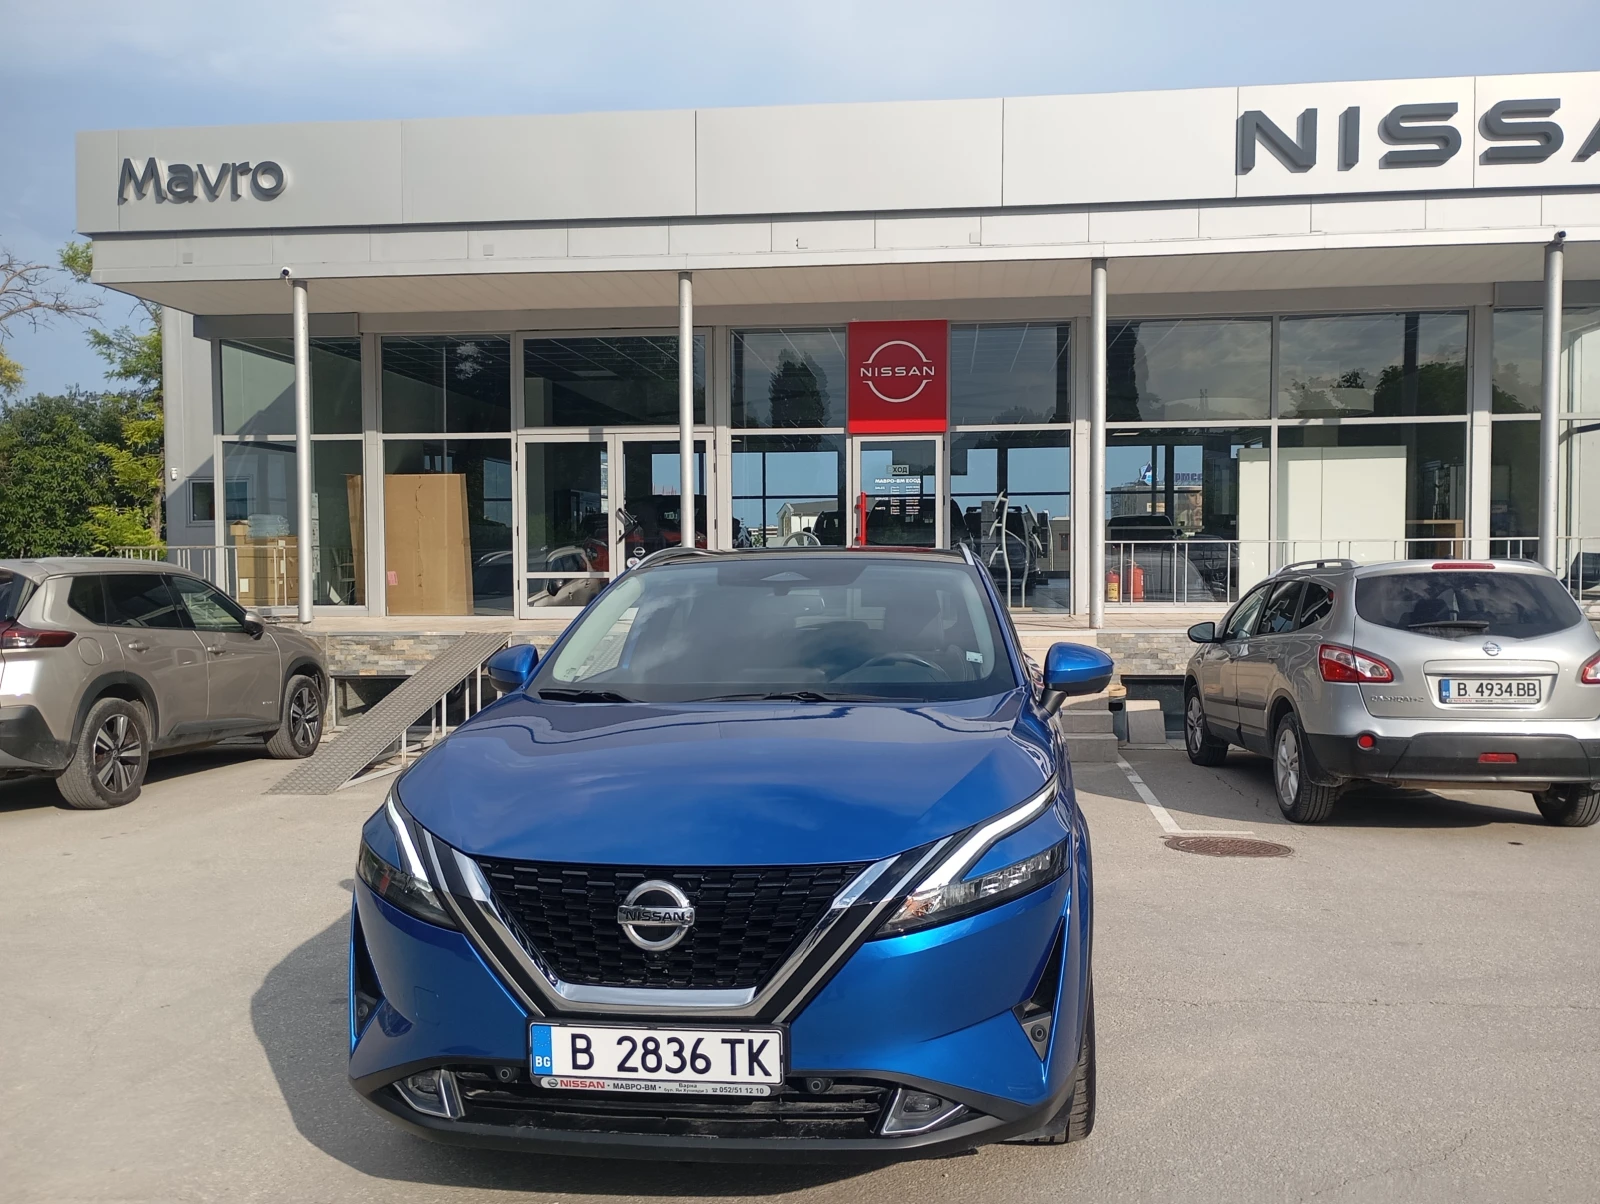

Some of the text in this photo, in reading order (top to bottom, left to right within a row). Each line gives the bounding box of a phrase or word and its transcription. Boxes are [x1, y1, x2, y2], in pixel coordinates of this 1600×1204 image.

[118, 157, 287, 203] Mavro
[860, 366, 935, 377] NISSAN
[1457, 682, 1468, 697] B
[1475, 682, 1514, 697] 4934
[1516, 682, 1537, 697] BB
[625, 911, 685, 922] NISSAN
[535, 1033, 773, 1077] BG B 2836 TK
[560, 1080, 606, 1090] NISSAN
[612, 1082, 657, 1092] МАВРО-ВМ
[719, 1086, 743, 1094] 052/51
